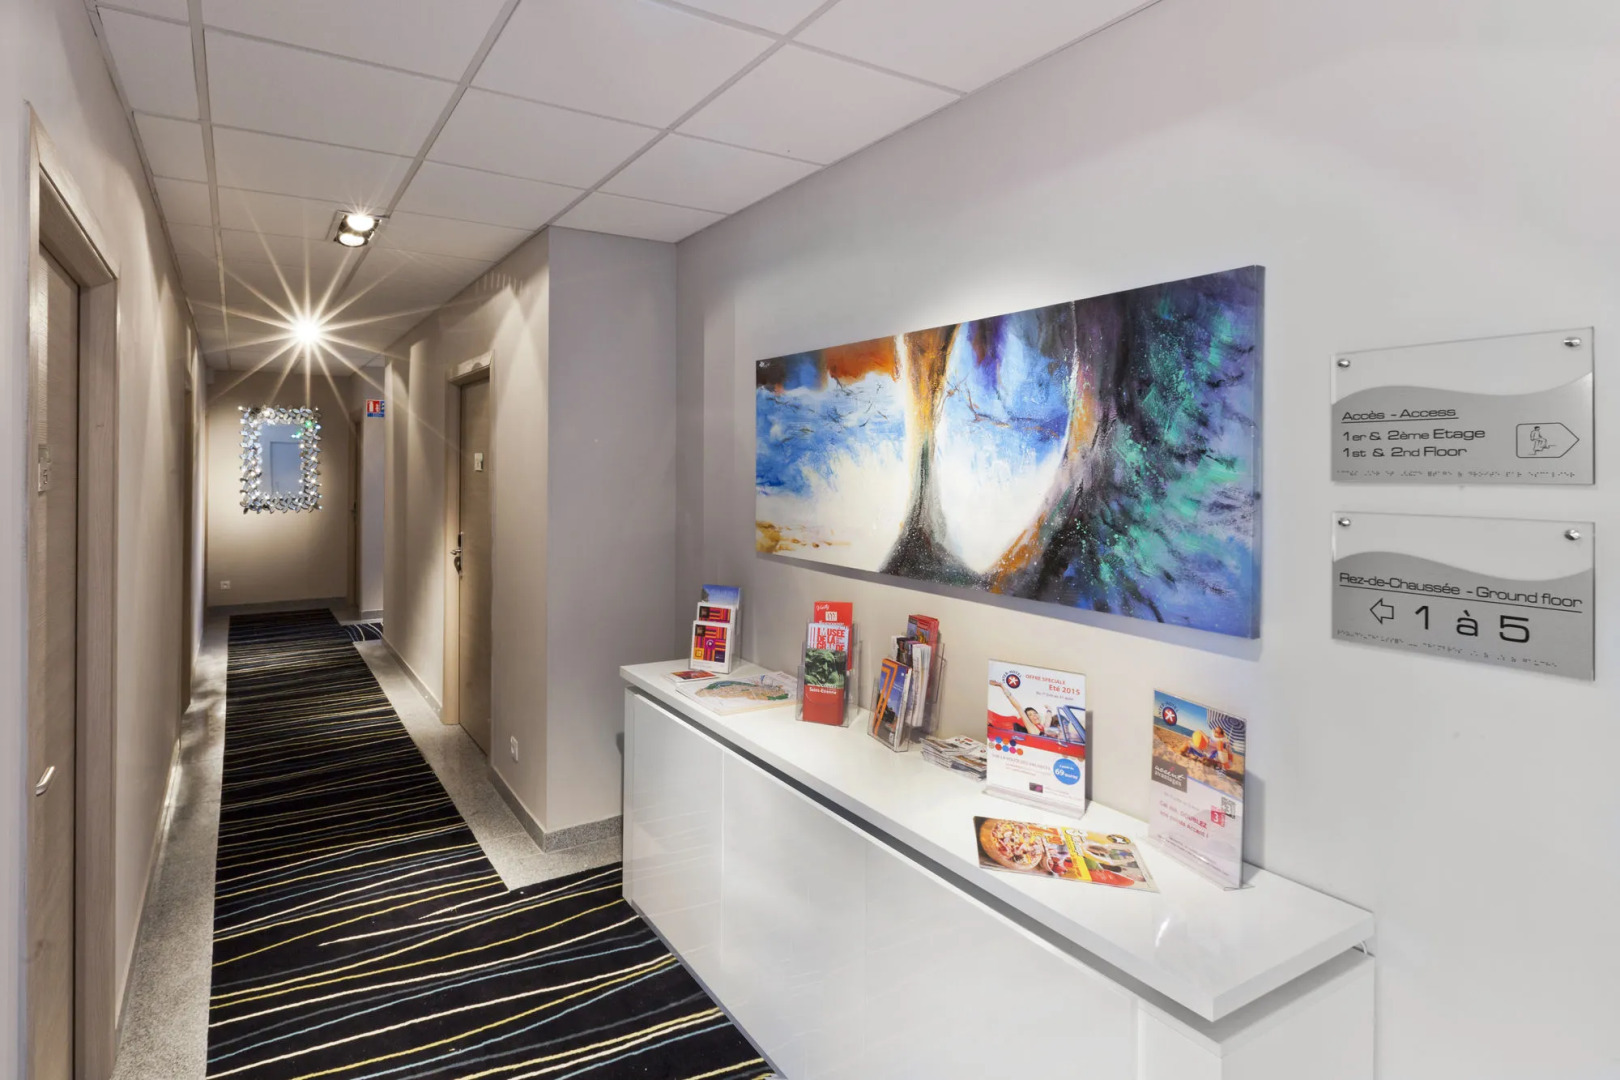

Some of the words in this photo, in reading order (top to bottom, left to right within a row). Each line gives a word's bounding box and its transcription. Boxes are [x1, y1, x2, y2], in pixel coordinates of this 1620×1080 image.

[1342, 411, 1385, 421] Accès
[1400, 409, 1457, 418] Access
[1343, 431, 1367, 441] 1er
[1369, 431, 1382, 441] &
[1388, 430, 1430, 441] 2ème
[1433, 428, 1486, 441] Etage
[1343, 447, 1366, 458] 1st
[1372, 448, 1385, 458] &
[1391, 447, 1420, 457] 2nd
[1424, 446, 1468, 457] Floor
[1339, 572, 1460, 595] Rez-de-Chaussée
[1476, 586, 1538, 604] Ground
[1542, 593, 1583, 608] floor
[1415, 605, 1429, 630] 1
[1456, 610, 1478, 637] à
[1500, 614, 1530, 643] 5
[1062, 686, 1080, 695] 2015
[1055, 768, 1065, 776] 69
